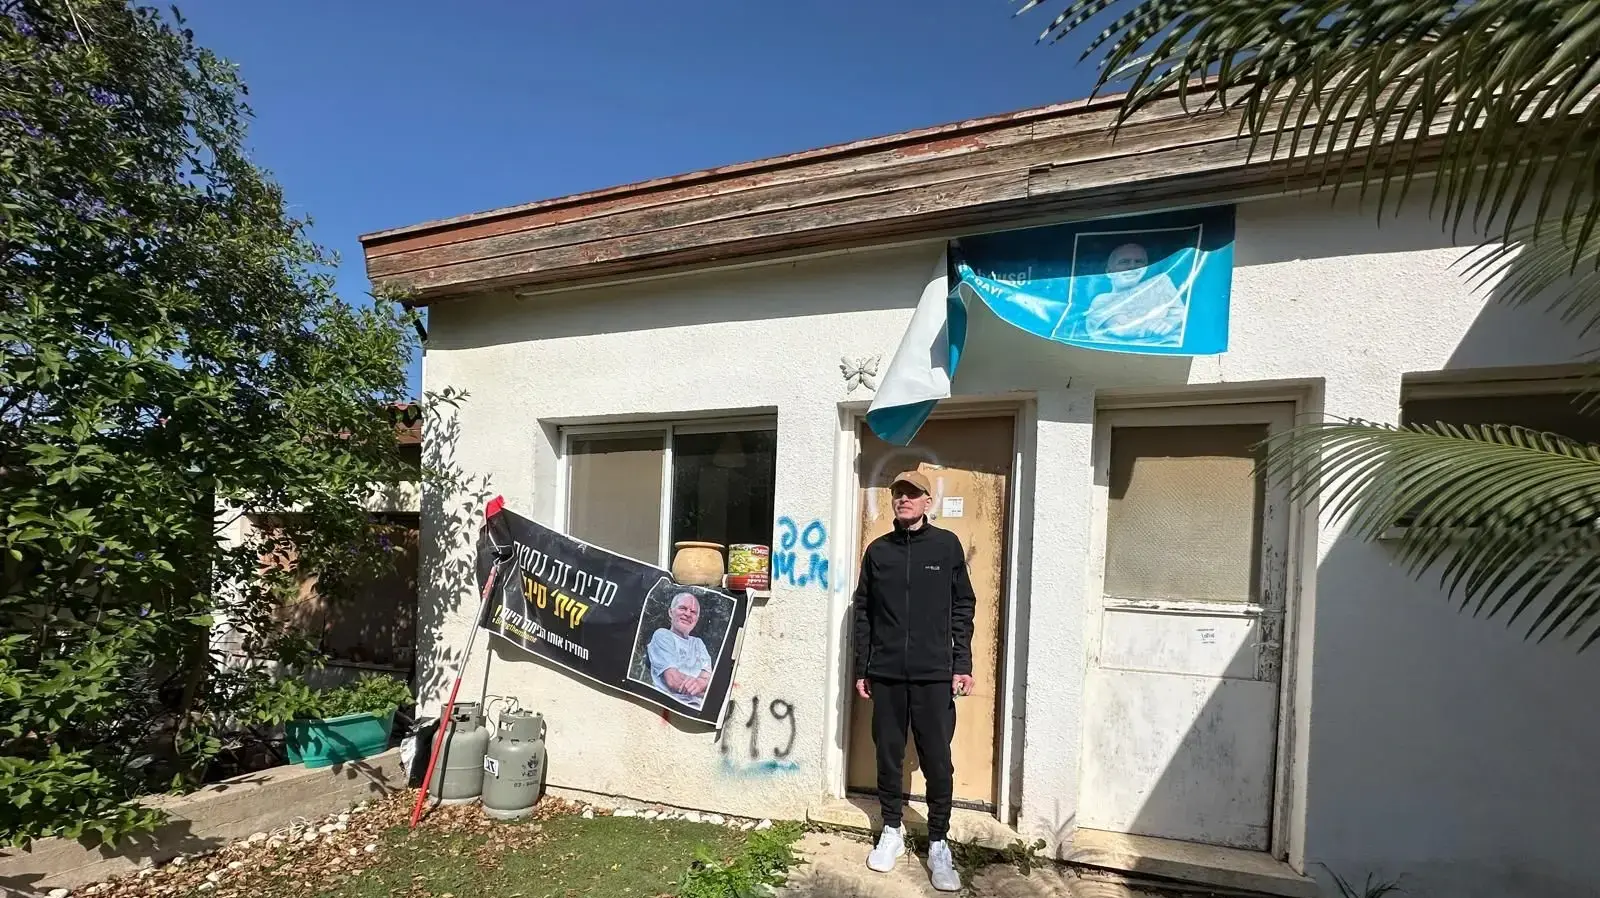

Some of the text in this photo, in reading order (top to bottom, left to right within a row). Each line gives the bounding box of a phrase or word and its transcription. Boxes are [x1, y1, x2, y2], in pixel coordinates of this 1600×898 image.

[547, 558, 573, 589] זה
[523, 575, 548, 610] סיג
[570, 568, 619, 608] מבית
[520, 618, 547, 641] הביתה
[547, 630, 565, 649] אותו
[564, 638, 590, 661] תחזירו
